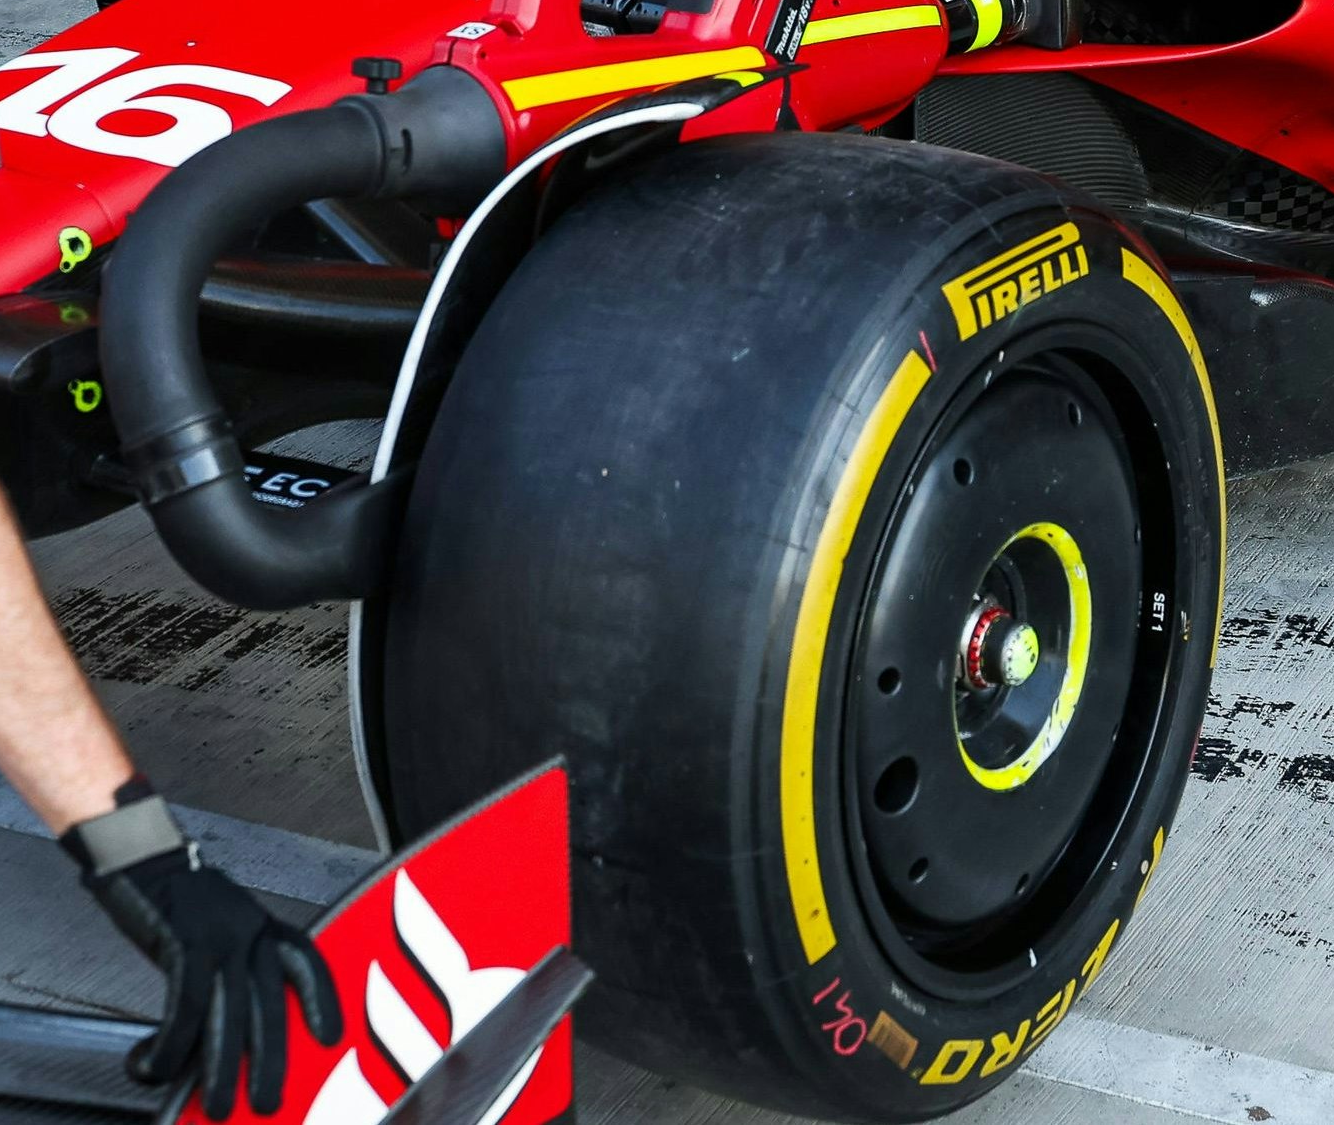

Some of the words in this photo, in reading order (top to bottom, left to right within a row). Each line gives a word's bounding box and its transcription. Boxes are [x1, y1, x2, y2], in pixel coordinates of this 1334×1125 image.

[942, 223, 1090, 342] PIRELLI
[1153, 592, 1165, 622] SET
[1151, 624, 1163, 632] 1
